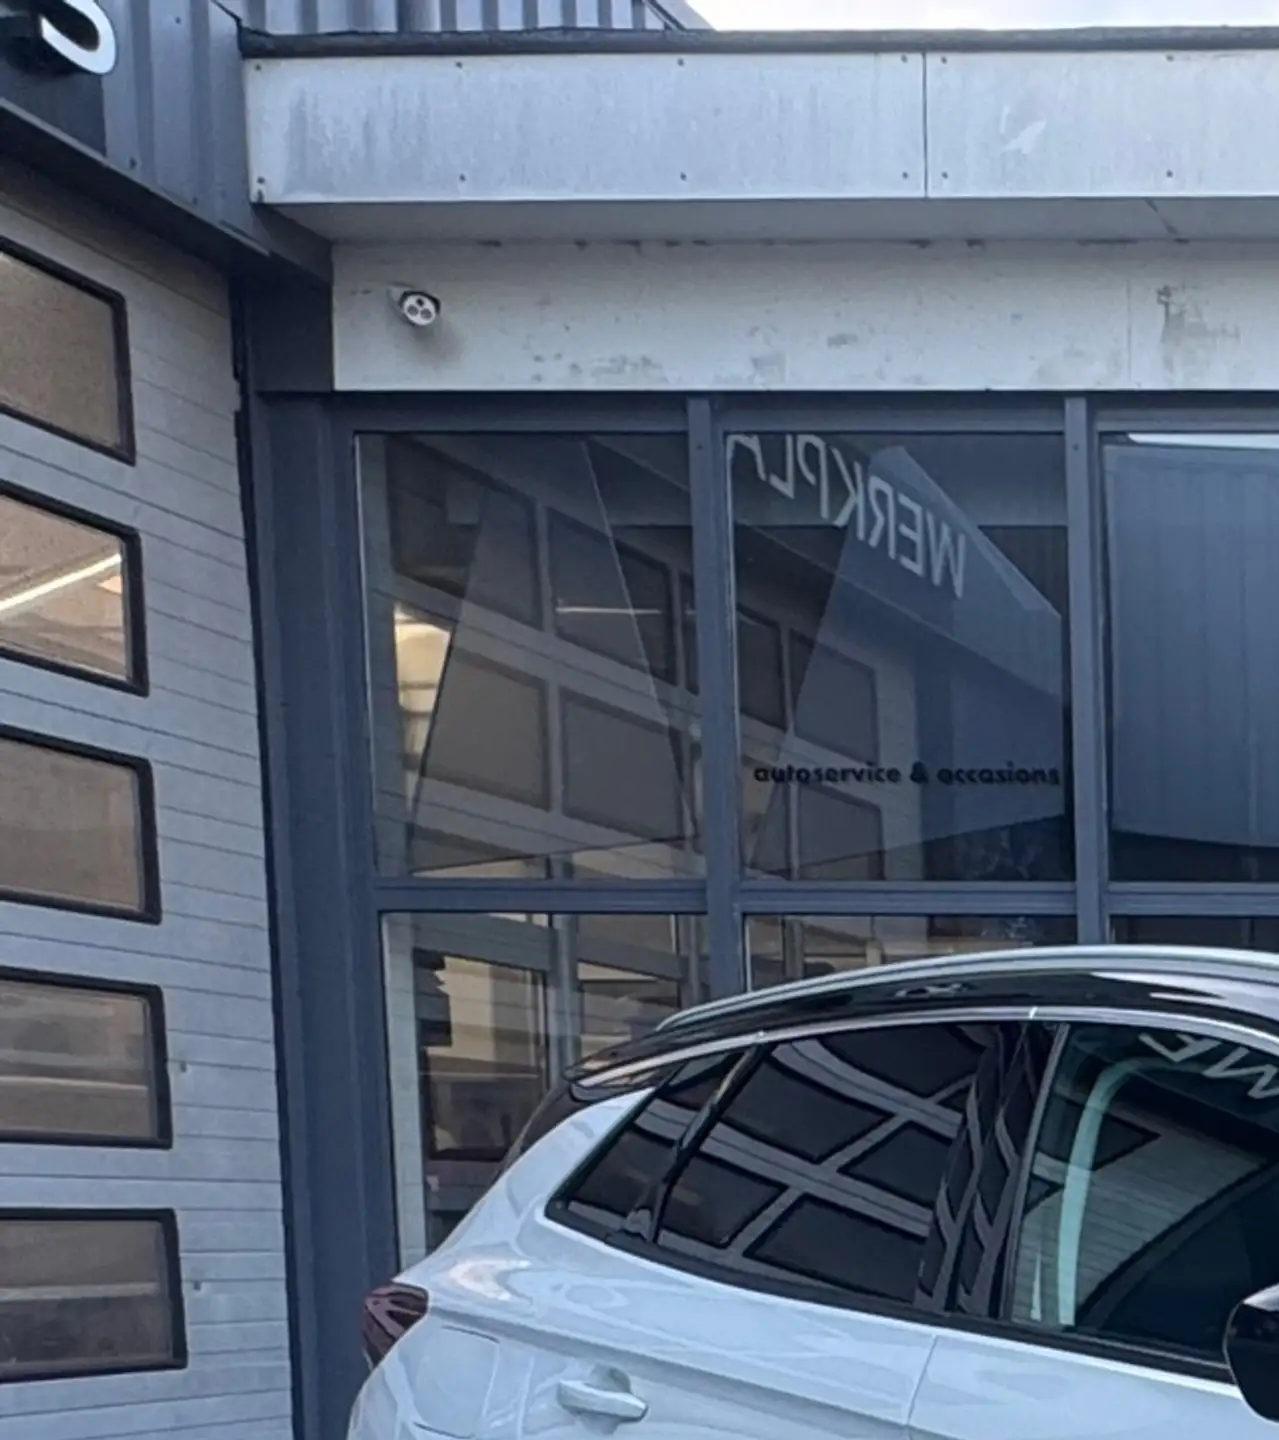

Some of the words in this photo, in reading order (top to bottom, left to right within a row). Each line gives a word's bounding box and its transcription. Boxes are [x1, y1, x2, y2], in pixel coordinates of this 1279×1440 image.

[753, 761, 902, 784] autoservice
[909, 761, 930, 784] &
[936, 761, 1061, 786] occasions
